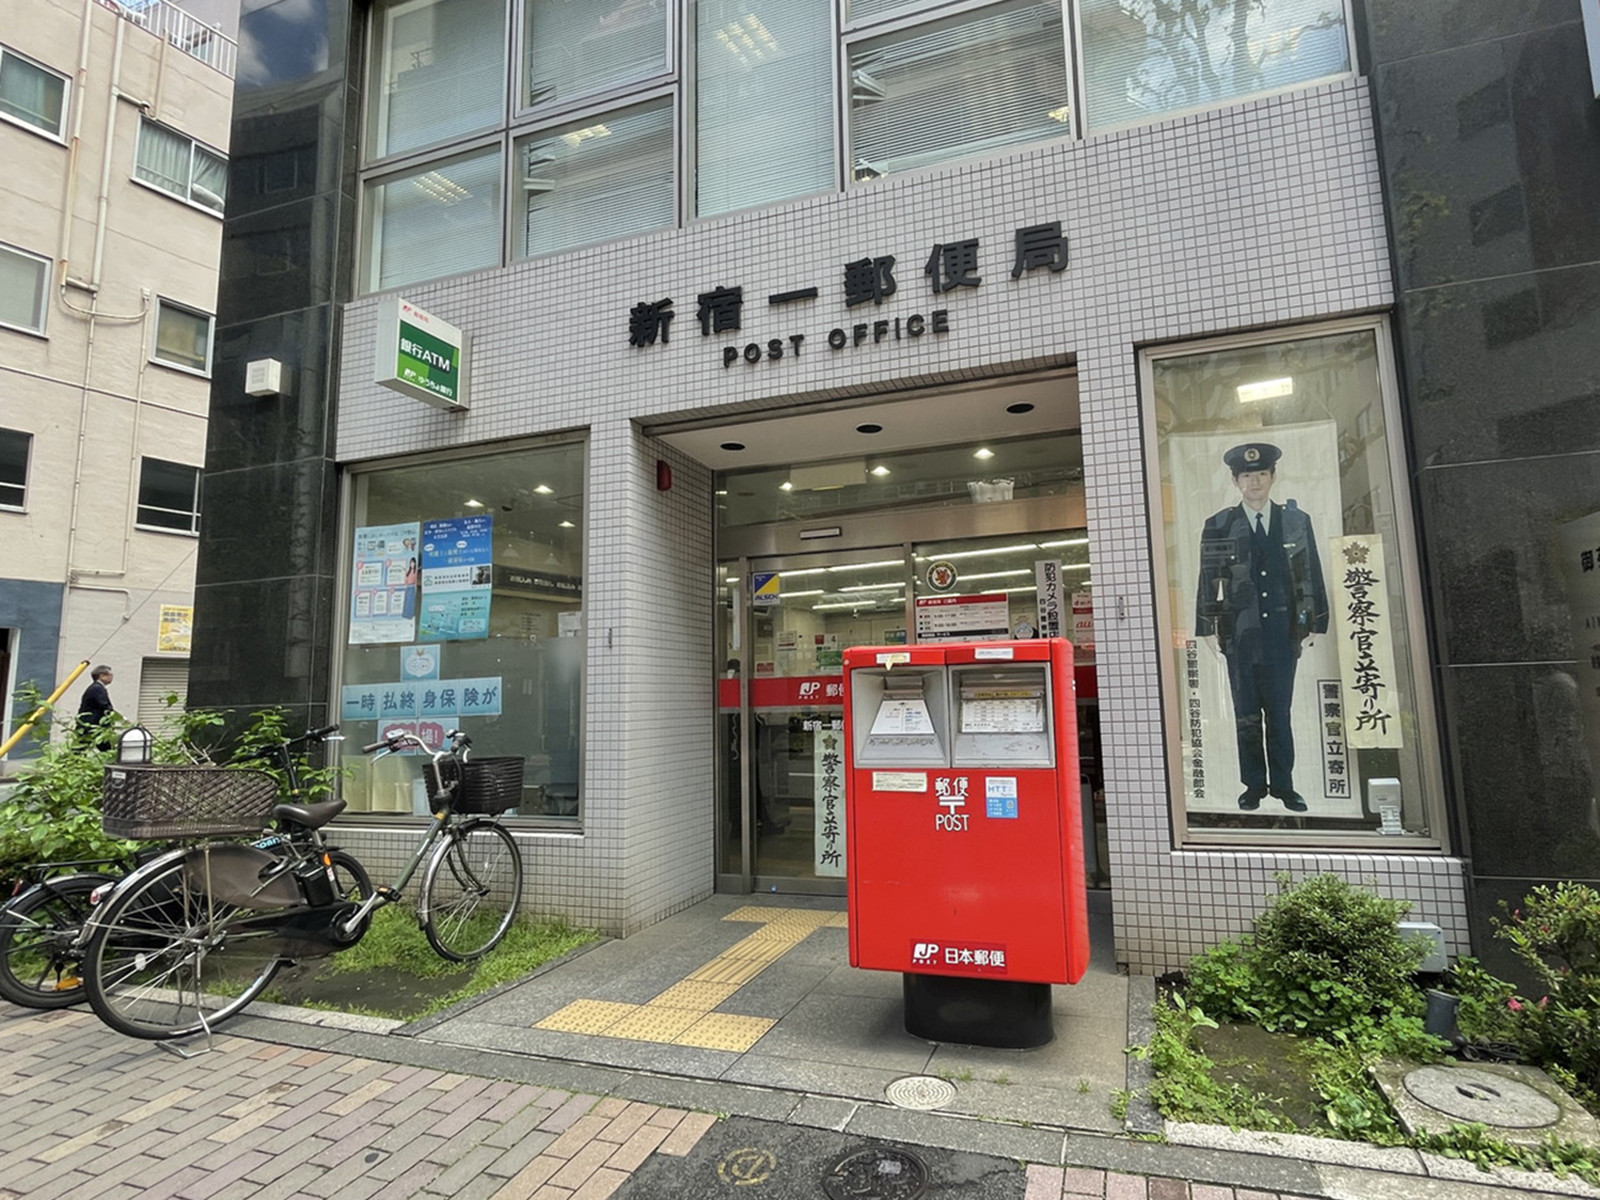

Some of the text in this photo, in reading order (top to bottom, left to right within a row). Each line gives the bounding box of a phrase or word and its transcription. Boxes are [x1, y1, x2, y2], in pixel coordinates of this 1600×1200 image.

[629, 220, 1068, 347] 新宿一郵便局
[724, 309, 950, 368] POST OFFICE
[401, 338, 450, 372] 銀行ATM
[1342, 567, 1392, 736] 警察官立寄り所
[346, 686, 499, 713] 一時払終身保険が
[803, 720, 844, 731] 新宿一郵
[1322, 683, 1346, 795] 警察官立寄所
[935, 777, 969, 797] 郵便
[935, 814, 969, 831] POST
[944, 948, 1005, 967] 日本郵便
